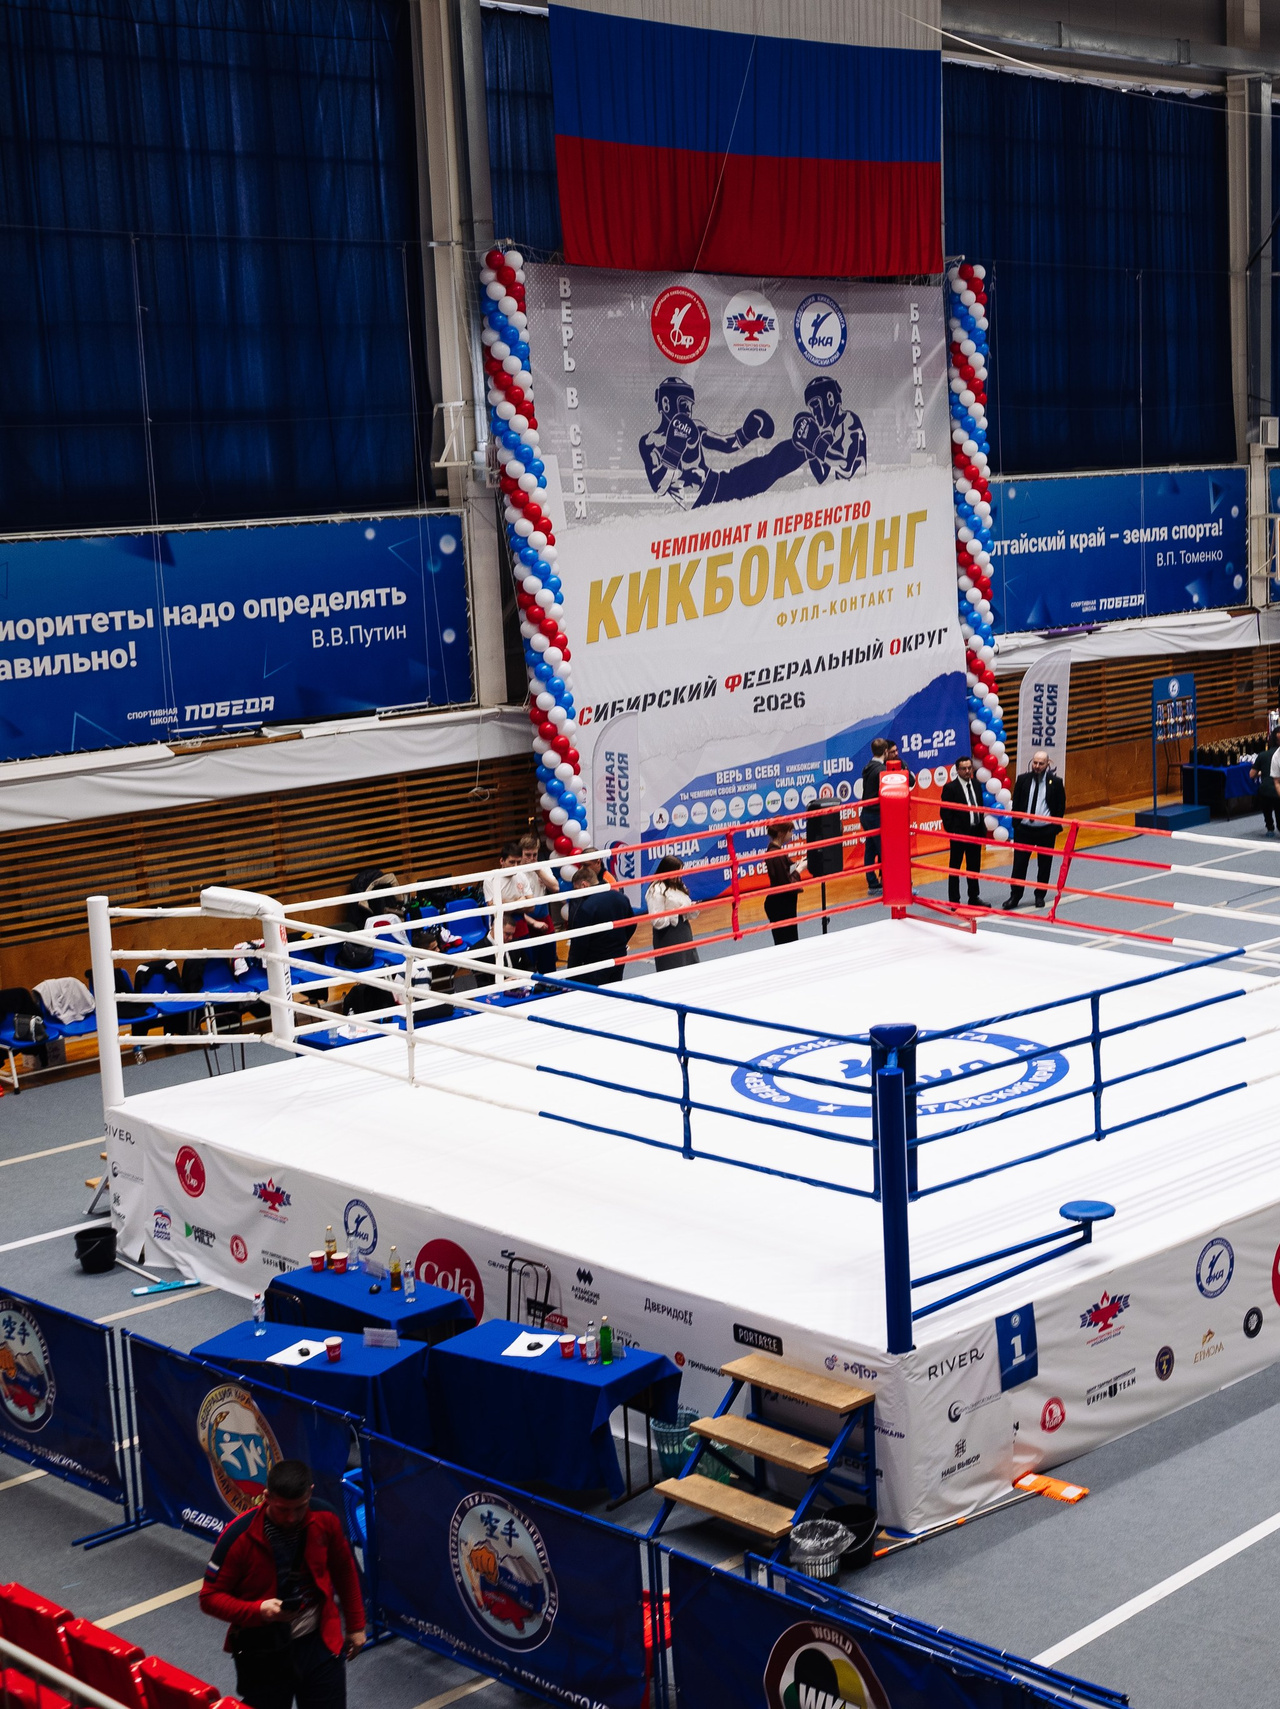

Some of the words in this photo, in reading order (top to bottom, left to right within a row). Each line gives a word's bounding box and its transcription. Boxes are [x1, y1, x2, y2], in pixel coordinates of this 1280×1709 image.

[558, 277, 576, 372] ВЕРЬ
[808, 336, 834, 350] ФКА
[909, 302, 926, 450] БАРНАУЛ
[566, 387, 579, 409] В
[569, 423, 588, 519] СЕБЯ
[650, 522, 753, 559] ЧЕМПИОНАТ
[757, 520, 768, 539] И
[772, 501, 871, 536] ПЕРВЕНСТВО
[1069, 527, 1106, 551] край
[1123, 525, 1168, 548] земля
[1172, 517, 1224, 543] спорта!
[1156, 551, 1177, 567] В.П.
[1179, 549, 1224, 565] Томенко
[585, 510, 929, 644] КИКБОКСИНГ
[0, 604, 154, 642] иоритеты
[163, 597, 236, 630] надо
[242, 584, 408, 625] определять
[776, 587, 895, 628] ФУЛЛ-КОНТАКТ
[1070, 599, 1097, 609] СПОРТИВНАЯ
[1082, 605, 1097, 613] ШКОЛА
[1099, 593, 1145, 611] ПОБЕДА
[311, 621, 408, 650] В.В.Путин
[0, 638, 138, 681] авильно!
[578, 675, 718, 727] СИБИРСКИЙ
[724, 637, 885, 692] ФЕДЕРАЛЬНЫЙ
[889, 626, 949, 657] ОКРУГ
[127, 707, 179, 721] СПОРТИВНАЯ
[184, 696, 275, 722] ПОБЕДА
[753, 690, 807, 714] 2026
[150, 715, 179, 726] ШКОЛА
[1031, 683, 1045, 747] ЕДИНАЯ
[1044, 684, 1058, 748] РОССИЯ
[901, 728, 956, 753] 18-22
[822, 757, 854, 777] ЦЕЛЬ
[918, 749, 939, 760] марта
[716, 769, 743, 785] ВЕРЬ
[745, 767, 753, 780] В
[754, 763, 781, 779] СЕБЯ
[775, 775, 795, 788] СИЛА
[795, 773, 815, 788] ДУХА
[604, 751, 617, 827] ЕДИНАЯ
[617, 752, 630, 829] РОССИЯ
[680, 793, 689, 801] ТЫ
[689, 788, 717, 799] ЧЕМПИОН
[718, 785, 737, 797] СВОЕЙ
[737, 782, 757, 793] ЖИЗНИ
[723, 866, 747, 881] ВРЬ
[191, 1225, 216, 1241] GREEN
[194, 1232, 214, 1248] HILL
[418, 1260, 476, 1302] Cola
[571, 1285, 600, 1300] АЛТАЙСКИЕ
[574, 1293, 598, 1306] КАРЬЕРЫ
[2, 1314, 31, 1346] 空手
[1010, 1334, 1026, 1366] 1
[843, 1361, 878, 1380] РОТОР
[928, 1348, 985, 1381] RIVER
[1119, 1376, 1137, 1392] TEAM
[874, 1426, 906, 1440] РТИКАЛЬ
[844, 1457, 884, 1479] СОТЯ
[941, 1464, 956, 1480] НАШ
[956, 1453, 981, 1472] ВЫБОР
[480, 1509, 520, 1548] 空手
[810, 1625, 854, 1655] WORLD
